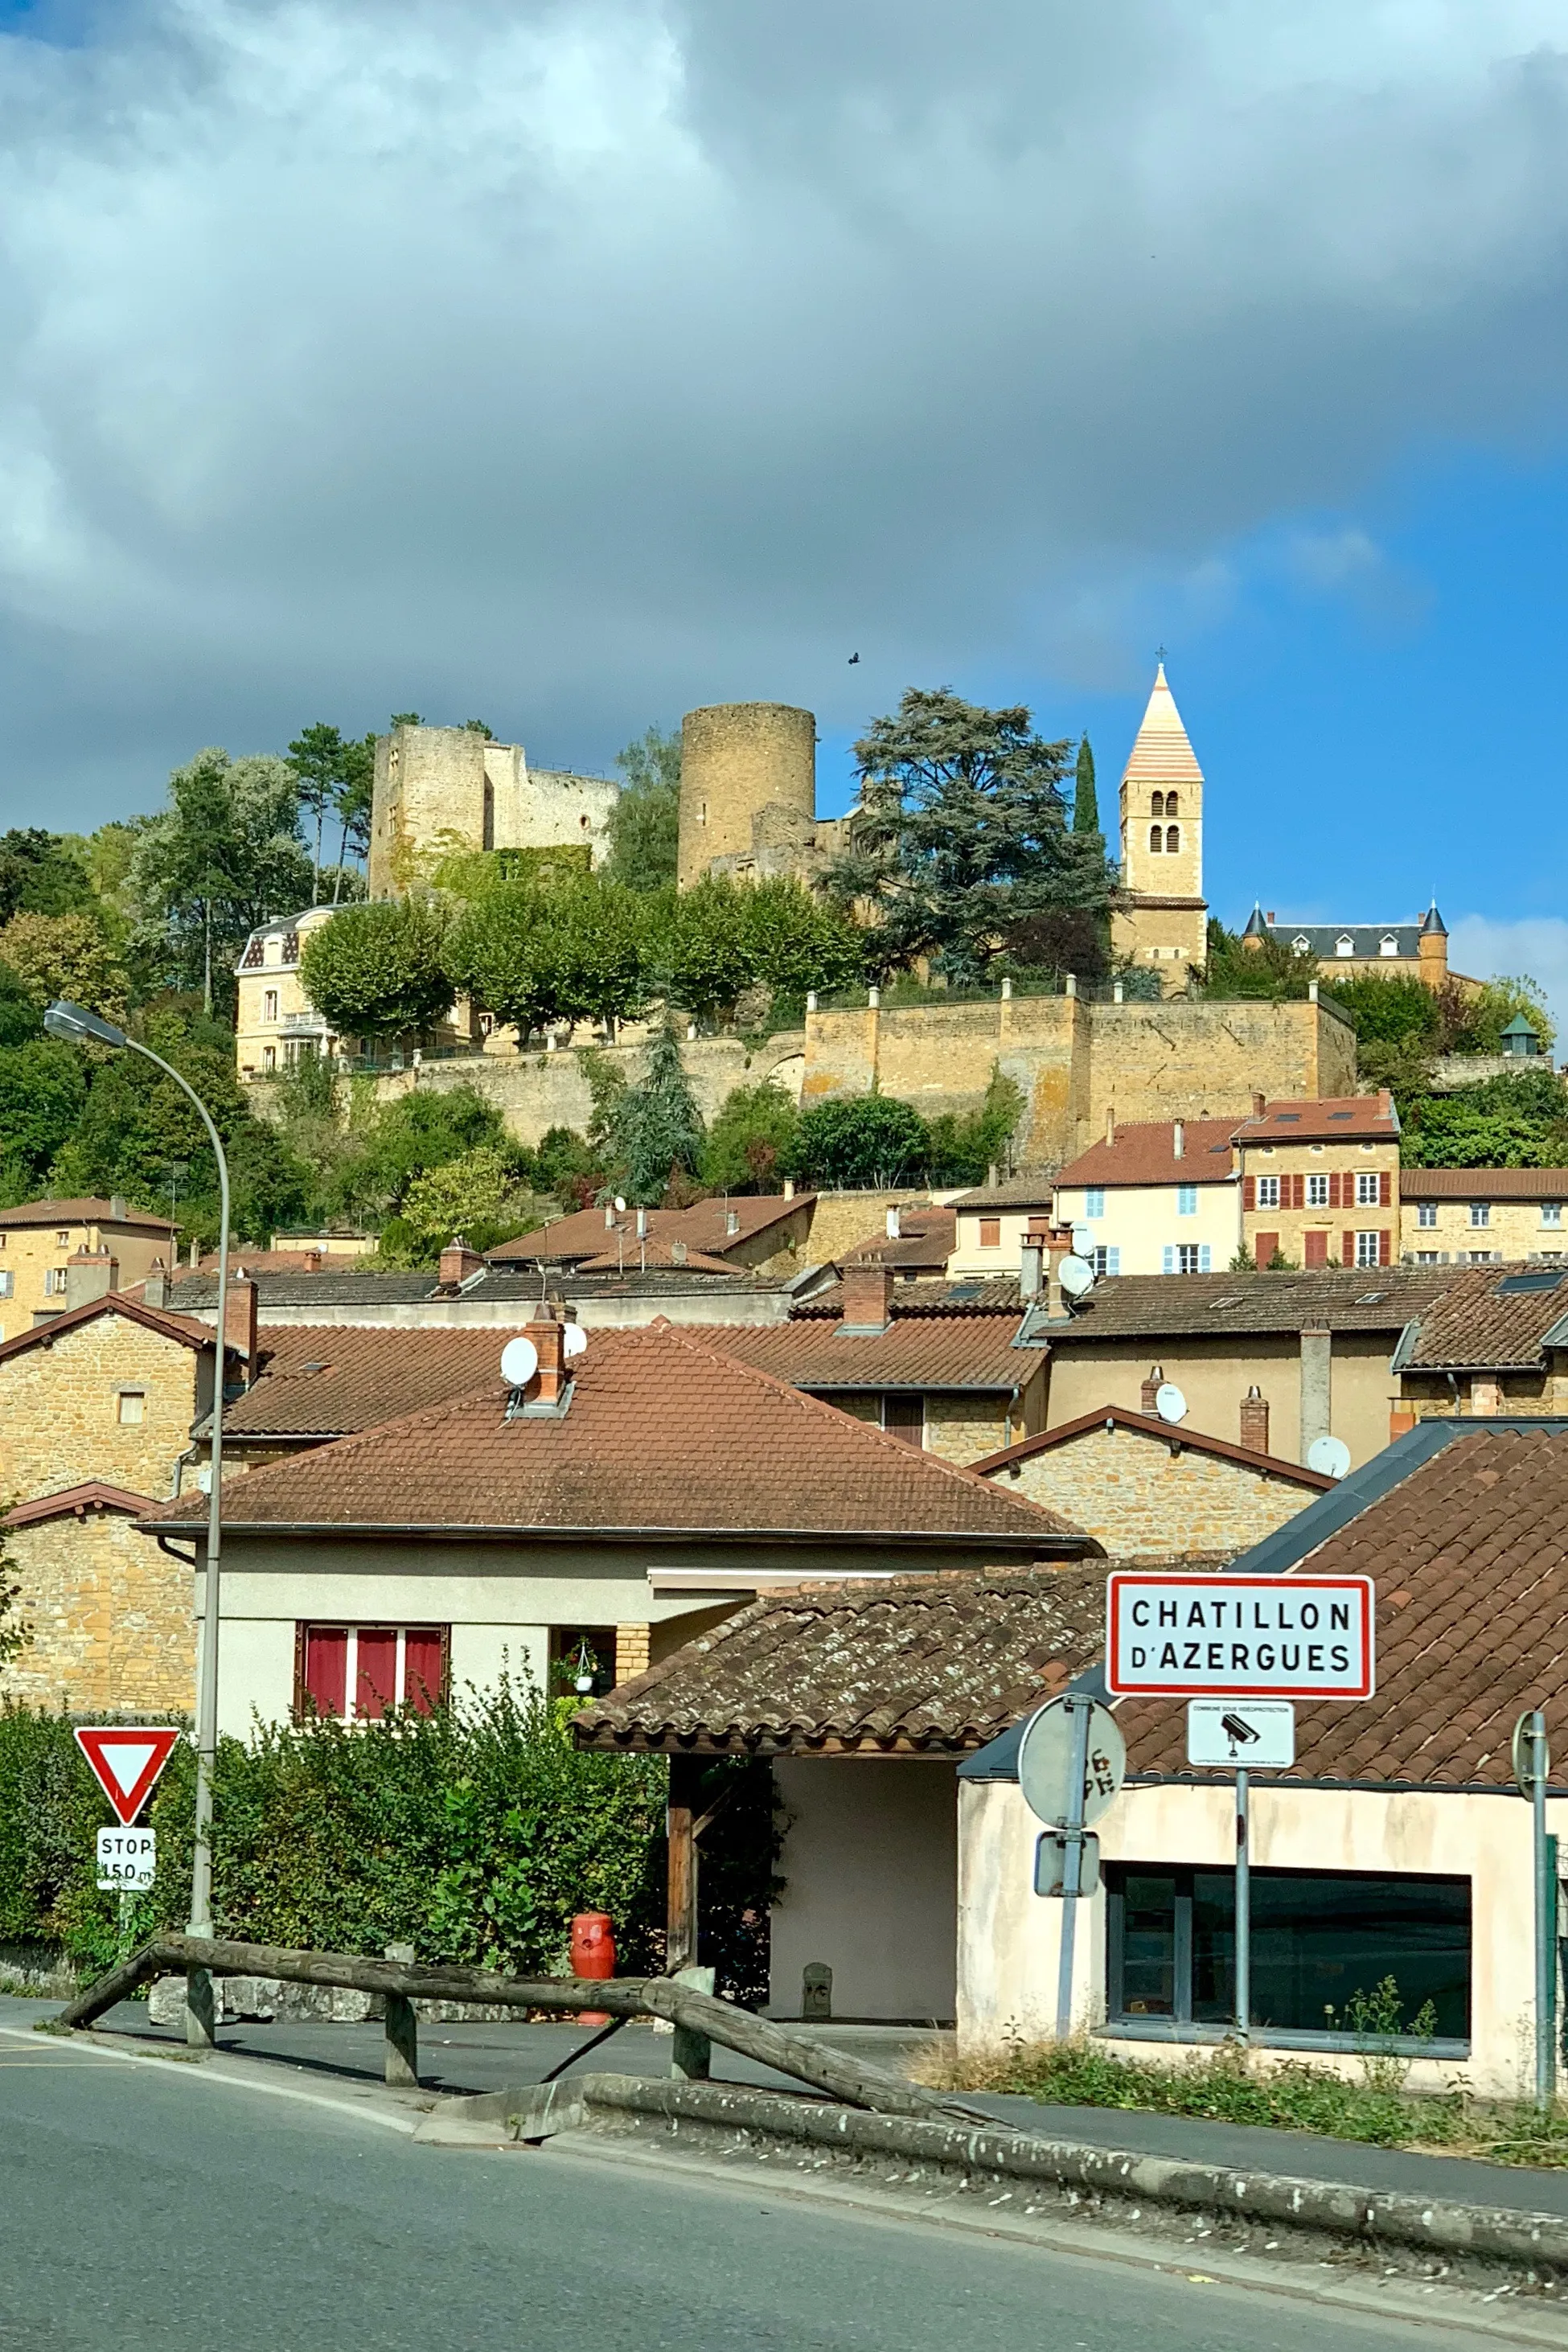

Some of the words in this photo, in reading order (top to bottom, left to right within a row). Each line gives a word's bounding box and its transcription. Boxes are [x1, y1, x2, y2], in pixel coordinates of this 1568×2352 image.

[1131, 1599, 1349, 1630] CHATILLON
[1131, 1642, 1349, 1672] D'AZERGUES
[101, 1838, 151, 1855] STOP
[104, 1863, 136, 1880] 150
